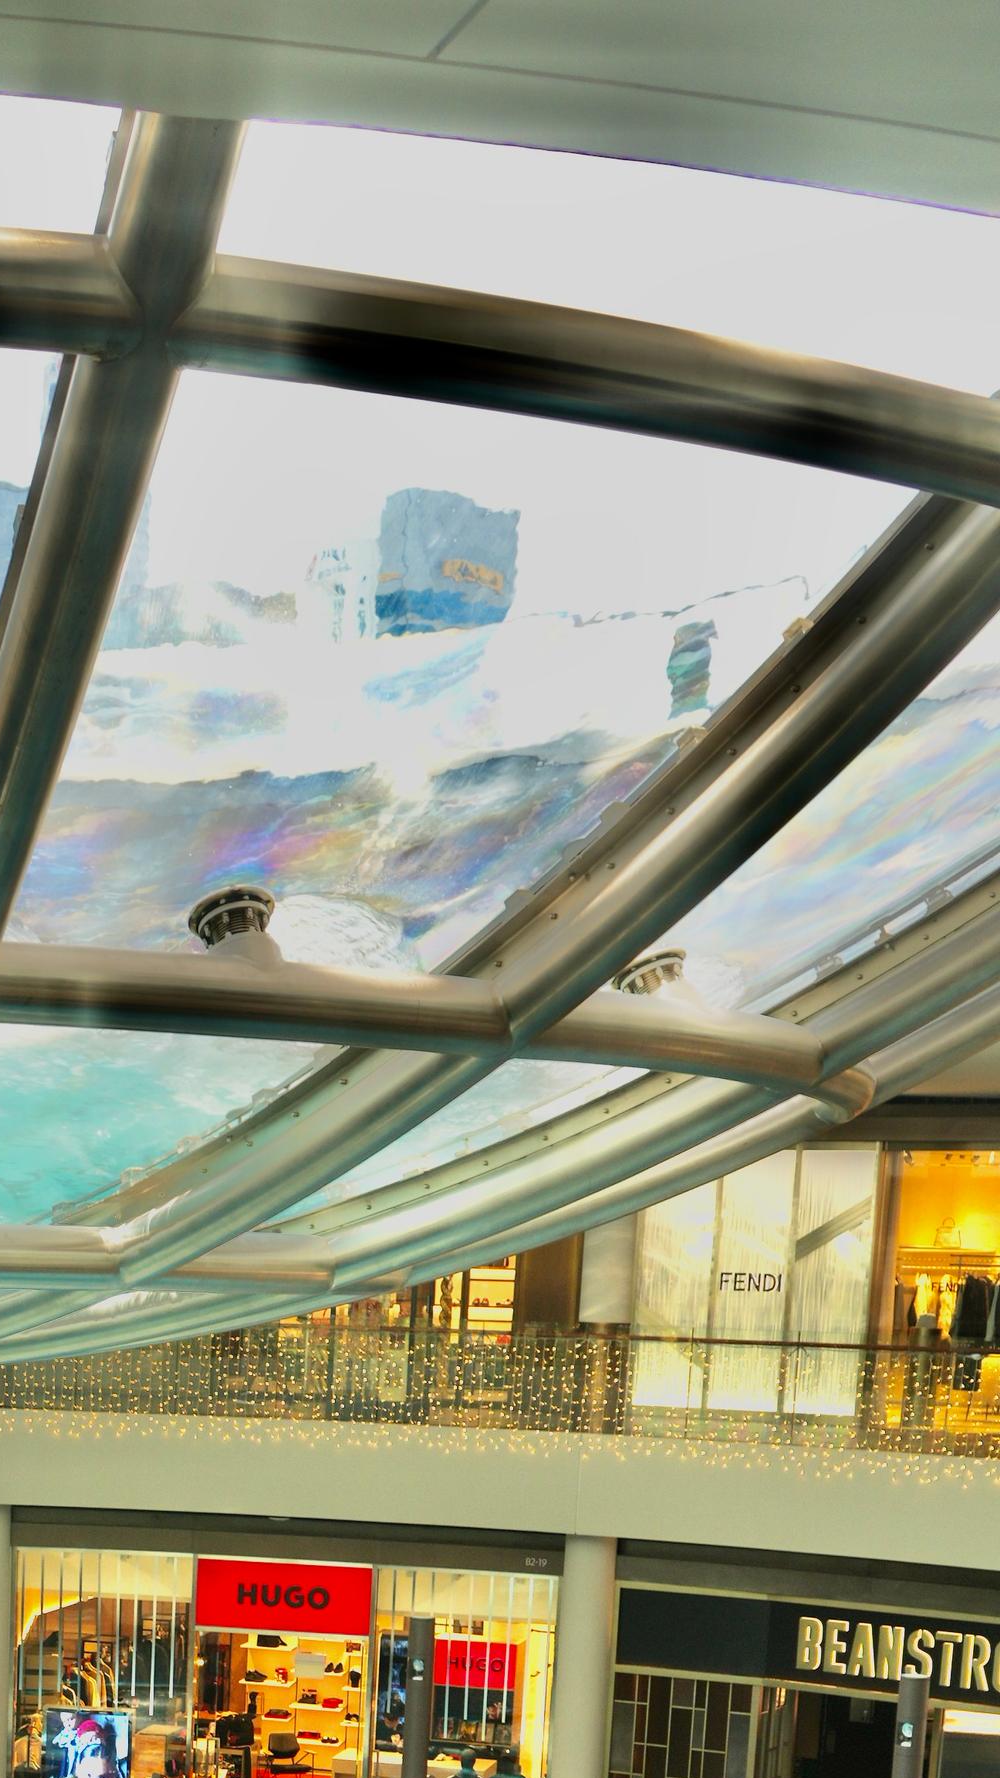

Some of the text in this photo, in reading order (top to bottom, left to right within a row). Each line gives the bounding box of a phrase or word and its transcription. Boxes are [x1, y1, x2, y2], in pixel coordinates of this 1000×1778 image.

[719, 1272, 782, 1292] FENDI
[237, 1583, 330, 1610] HUGO
[448, 1656, 505, 1673] HUGO
